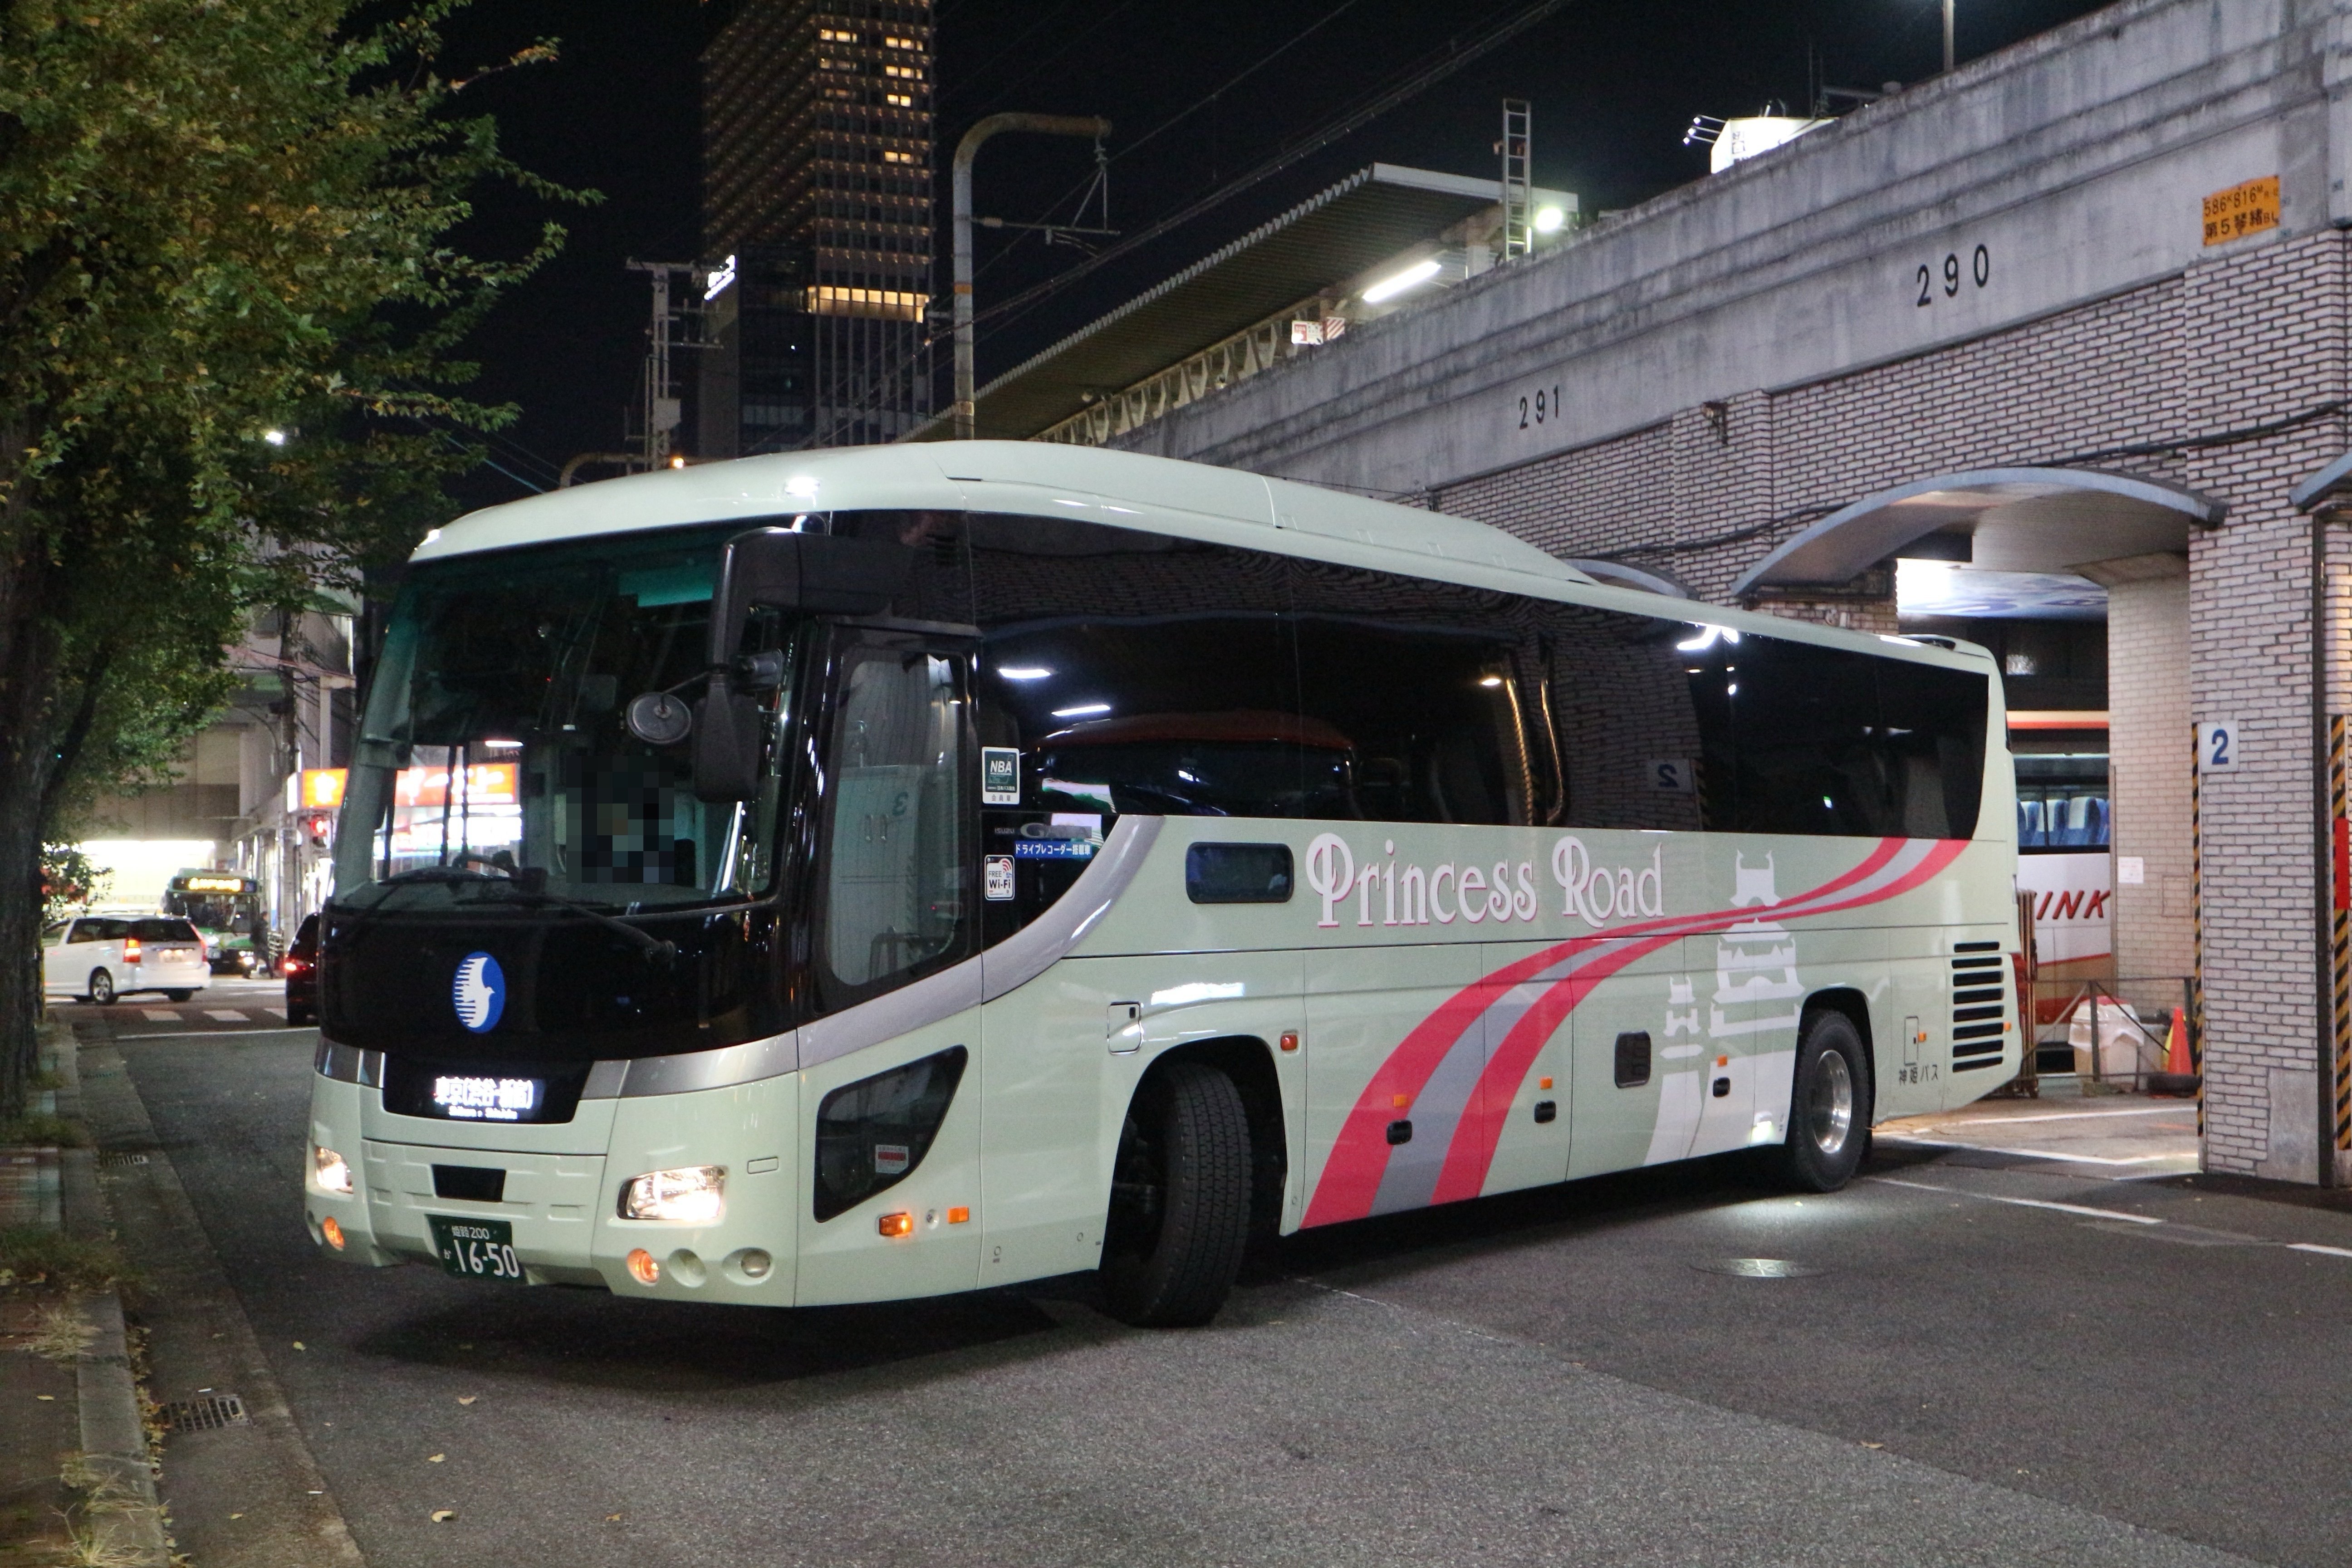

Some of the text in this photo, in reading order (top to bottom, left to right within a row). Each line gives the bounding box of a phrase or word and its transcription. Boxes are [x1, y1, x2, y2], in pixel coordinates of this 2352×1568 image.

[1916, 244, 1990, 307] 290
[1518, 384, 1559, 430] 291
[2211, 729, 2229, 765] 2
[990, 760, 1012, 773] NBA
[989, 879, 1010, 889] Wi-Fi
[1305, 833, 1665, 928] Princess Road
[2034, 889, 2111, 920] INK
[1898, 1064, 1939, 1087] 神姫バス
[453, 1239, 520, 1278] 16-50
